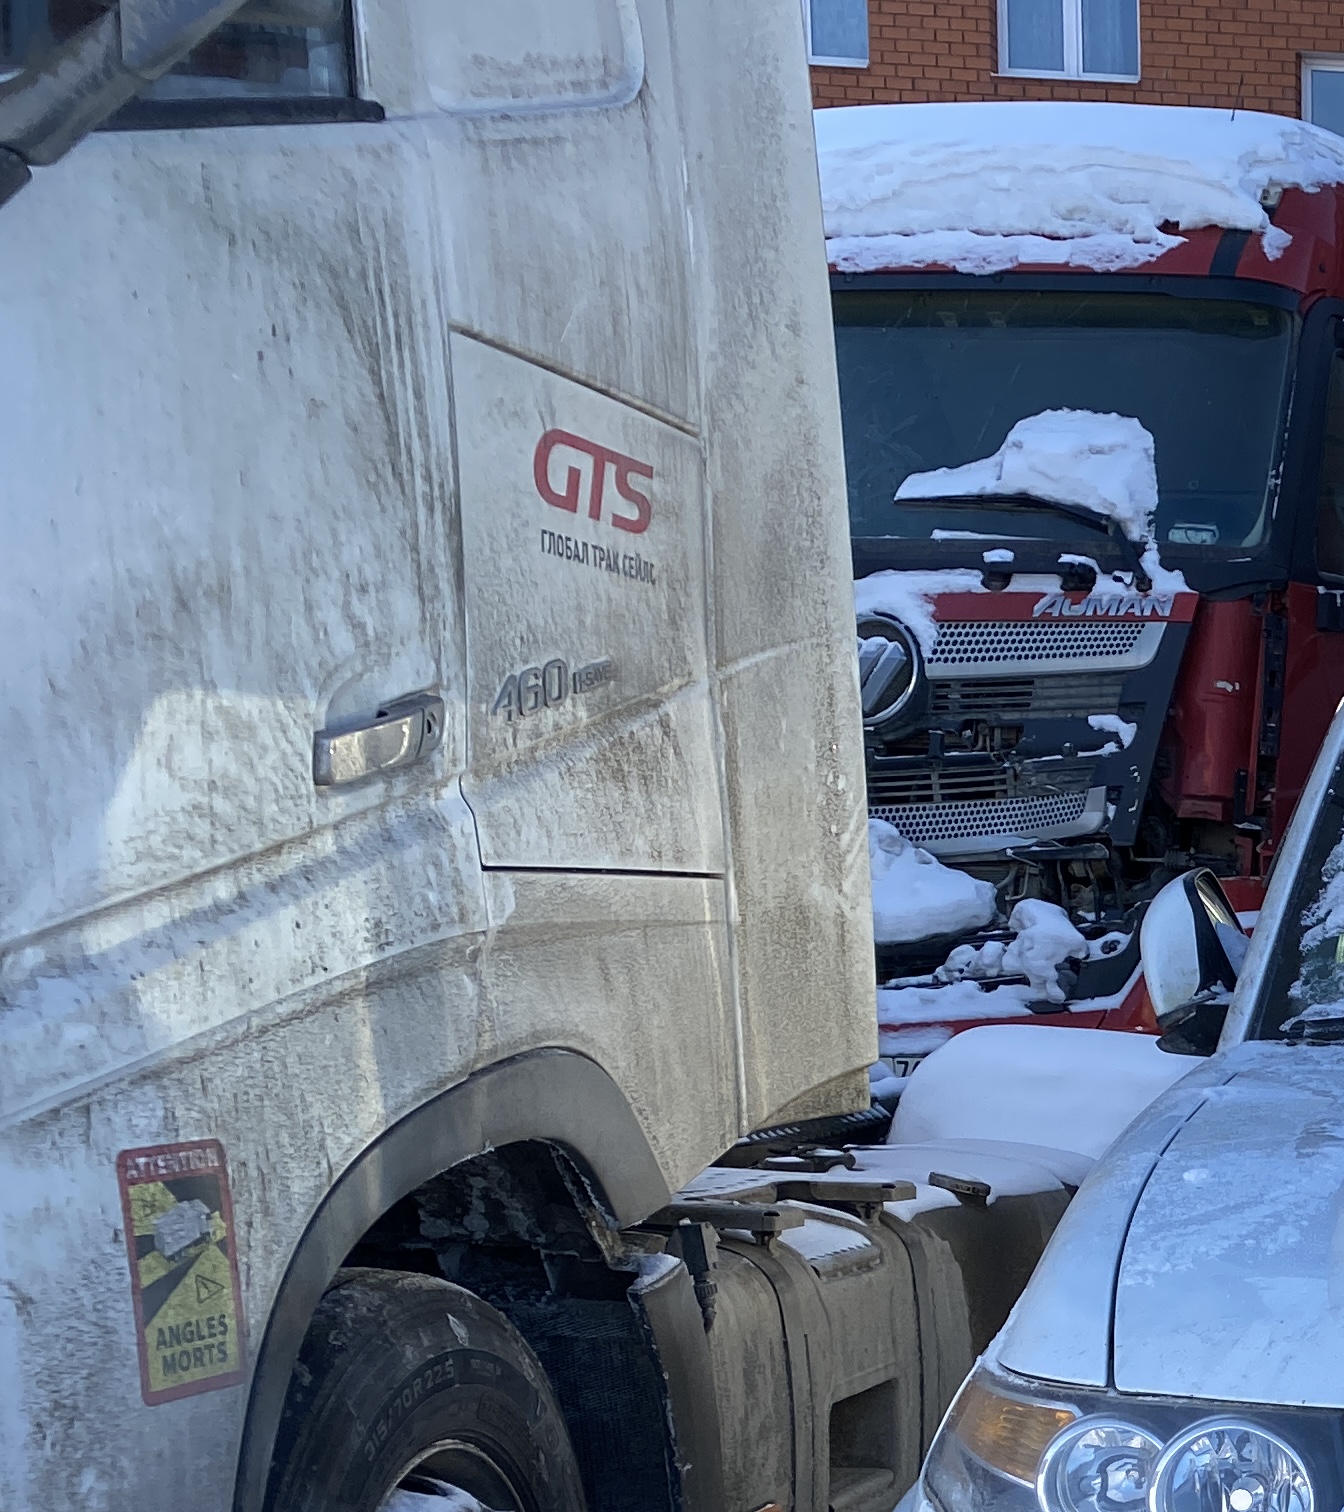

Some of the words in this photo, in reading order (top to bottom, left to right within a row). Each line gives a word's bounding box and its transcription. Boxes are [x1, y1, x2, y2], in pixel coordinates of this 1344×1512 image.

[533, 427, 654, 534] GTS
[541, 529, 590, 566] ГЛОБАЛ
[591, 543, 621, 575] ТРАК
[622, 551, 657, 586] СЕЙЛС
[1032, 594, 1175, 618] AUMAN
[491, 658, 569, 721] 460
[156, 1313, 229, 1350] ANGLES
[162, 1341, 229, 1377] MORTS
